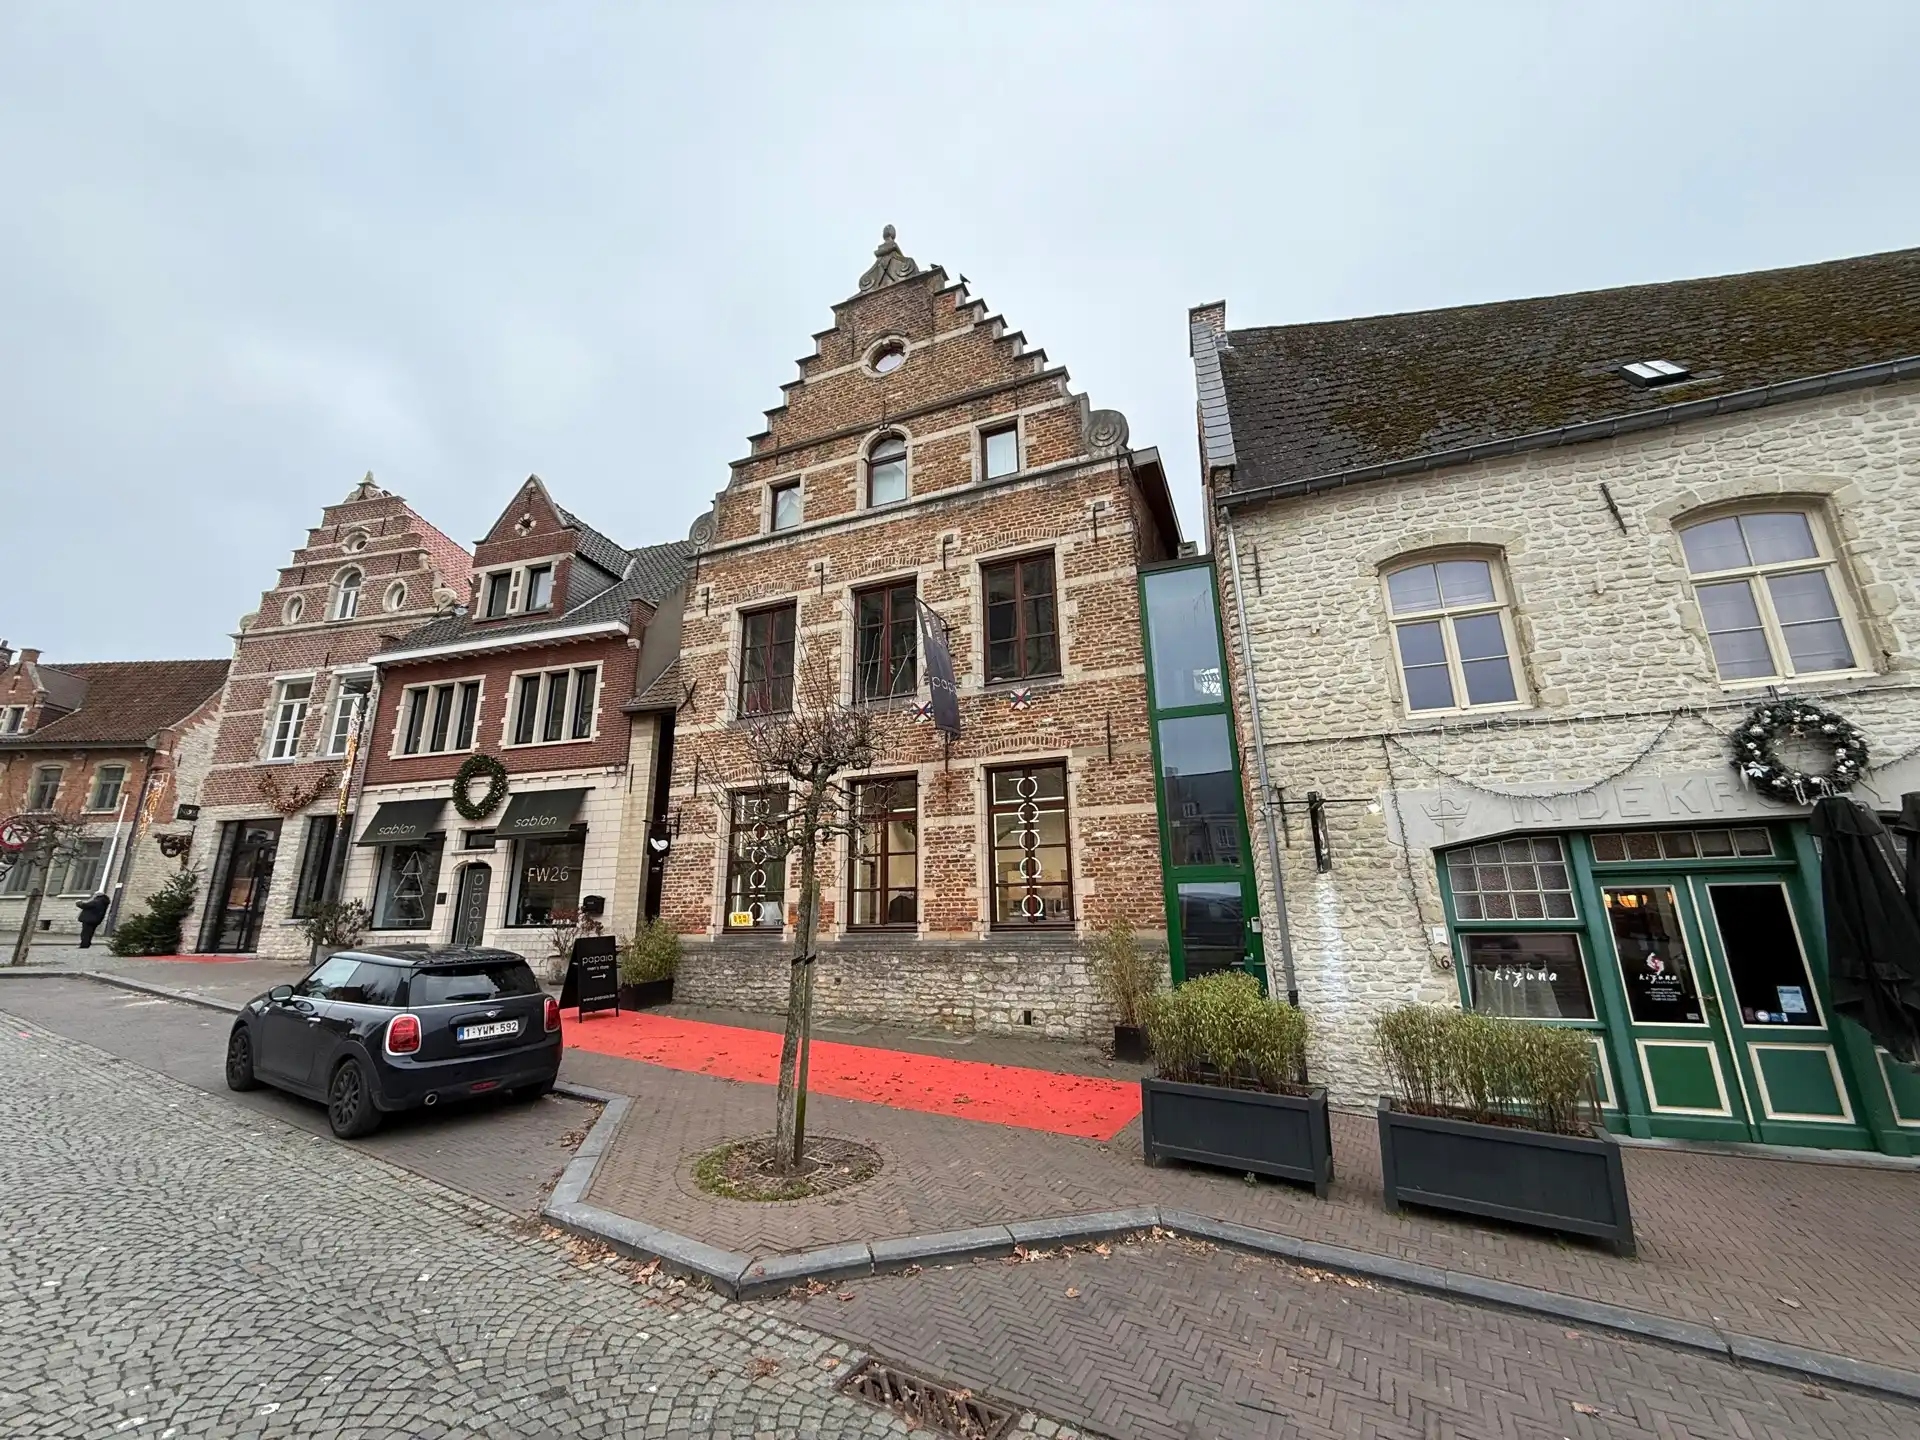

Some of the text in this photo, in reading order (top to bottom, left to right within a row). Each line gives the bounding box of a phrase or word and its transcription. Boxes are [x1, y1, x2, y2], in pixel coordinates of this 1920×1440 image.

[514, 815, 558, 828] sablon
[377, 824, 416, 836] sablon
[1008, 775, 1043, 917] papaia
[527, 865, 569, 882] FW26
[582, 954, 614, 966] papaia
[1441, 955, 1450, 970] 6
[1494, 969, 1558, 988] kizuna
[1639, 973, 1677, 985] kizuna
